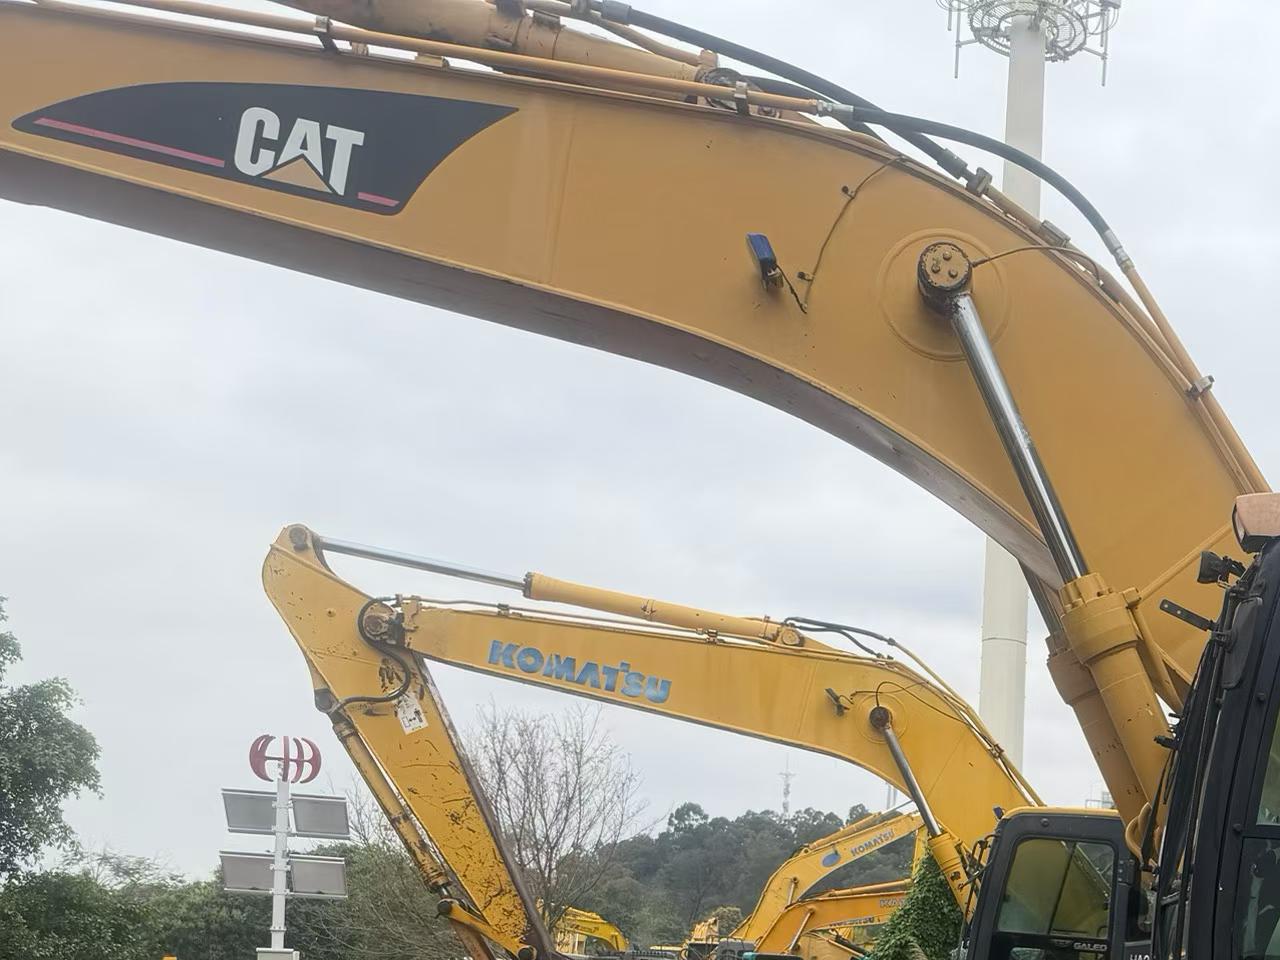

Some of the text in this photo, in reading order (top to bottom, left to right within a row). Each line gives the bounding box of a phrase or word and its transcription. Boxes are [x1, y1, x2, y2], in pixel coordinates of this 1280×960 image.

[234, 106, 365, 196] CAT
[488, 640, 673, 704] KOMATSU
[850, 827, 895, 857] KOMATSU
[1073, 942, 1107, 951] GALEO
